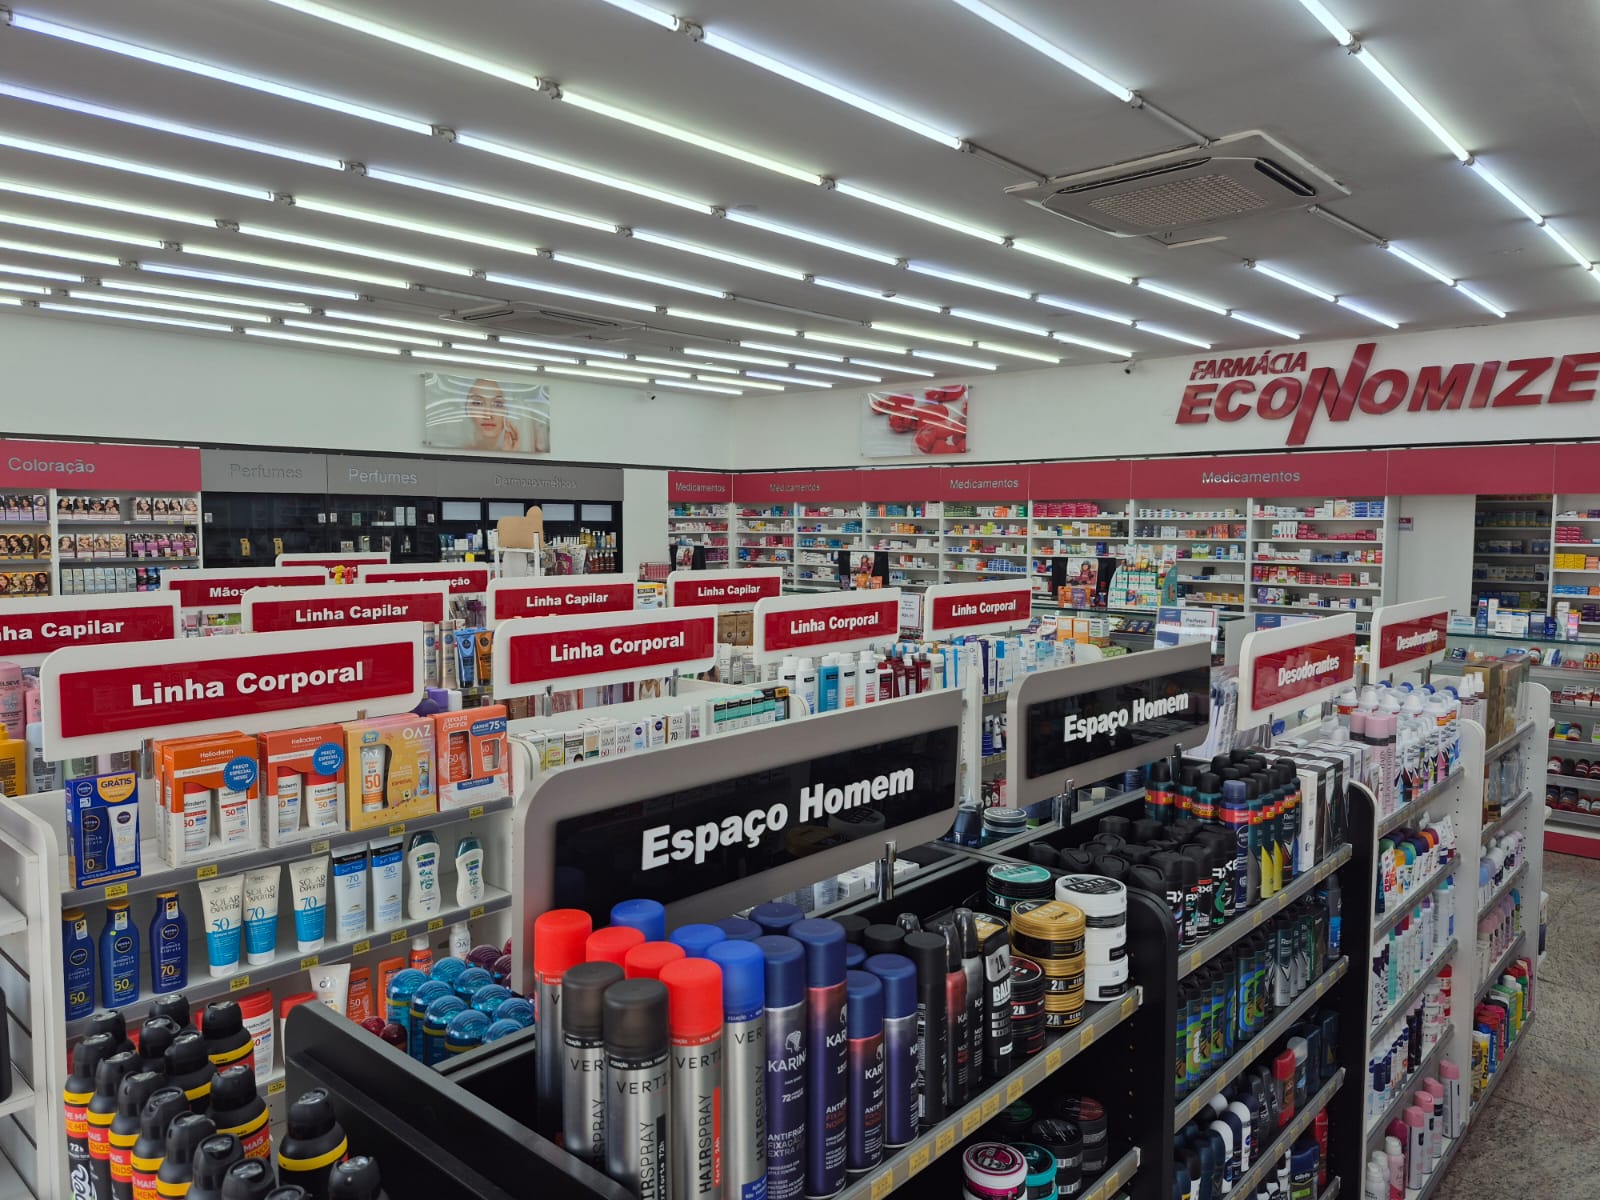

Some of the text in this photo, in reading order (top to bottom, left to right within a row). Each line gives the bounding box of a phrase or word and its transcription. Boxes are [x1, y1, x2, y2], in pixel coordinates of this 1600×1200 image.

[1190, 349, 1308, 382] FARMÁCIA
[1175, 342, 1600, 446] ECONOMIZE
[7, 456, 96, 475] Coloração
[229, 463, 304, 479] Perfumes
[349, 468, 418, 484] Perfumes
[949, 477, 1020, 490] Medicamentos
[1202, 469, 1301, 485] Medicamentos
[675, 481, 727, 493] Medicamentos
[697, 583, 762, 597] Linha Capilar
[526, 592, 609, 608] Linha Capilar
[952, 599, 1017, 617] Linha Corporal
[295, 603, 409, 623] Linha Capilar
[41, 619, 125, 639] Capilar
[790, 611, 880, 635] Linha Corporal
[550, 631, 685, 664] Linha Corporal
[1397, 628, 1439, 651] Desodorantes
[1277, 655, 1340, 687] Desodorantes
[131, 660, 364, 707] Linha Corporal
[1063, 692, 1189, 743] Espaço Homem
[100, 777, 132, 789] GRÁTIS
[364, 773, 381, 790] 50
[225, 808, 236, 817] 50
[641, 767, 914, 871] Espaço Homem
[1225, 859, 1239, 871] XE
[209, 895, 240, 907] SOLAR
[300, 896, 317, 911] 70
[995, 896, 1006, 907] 2A
[1166, 890, 1184, 903] AX
[1185, 893, 1199, 902] AX
[247, 906, 265, 920] 70
[211, 918, 230, 931] 50
[161, 965, 175, 977] 70
[114, 978, 130, 992] 50
[1051, 979, 1064, 991] 2A
[70, 991, 86, 1005] 50
[1012, 1005, 1026, 1015] 2A
[1046, 1014, 1060, 1025] 2A
[735, 1027, 763, 1044] VER
[826, 1030, 847, 1048] KAR
[570, 1058, 604, 1072] VER
[865, 1062, 884, 1079] KAR
[617, 1072, 668, 1095] VERTI
[243, 1136, 264, 1152] MAIS
[699, 1095, 712, 1194] HAIRSPRAY
[768, 1147, 796, 1158] EXTRA
